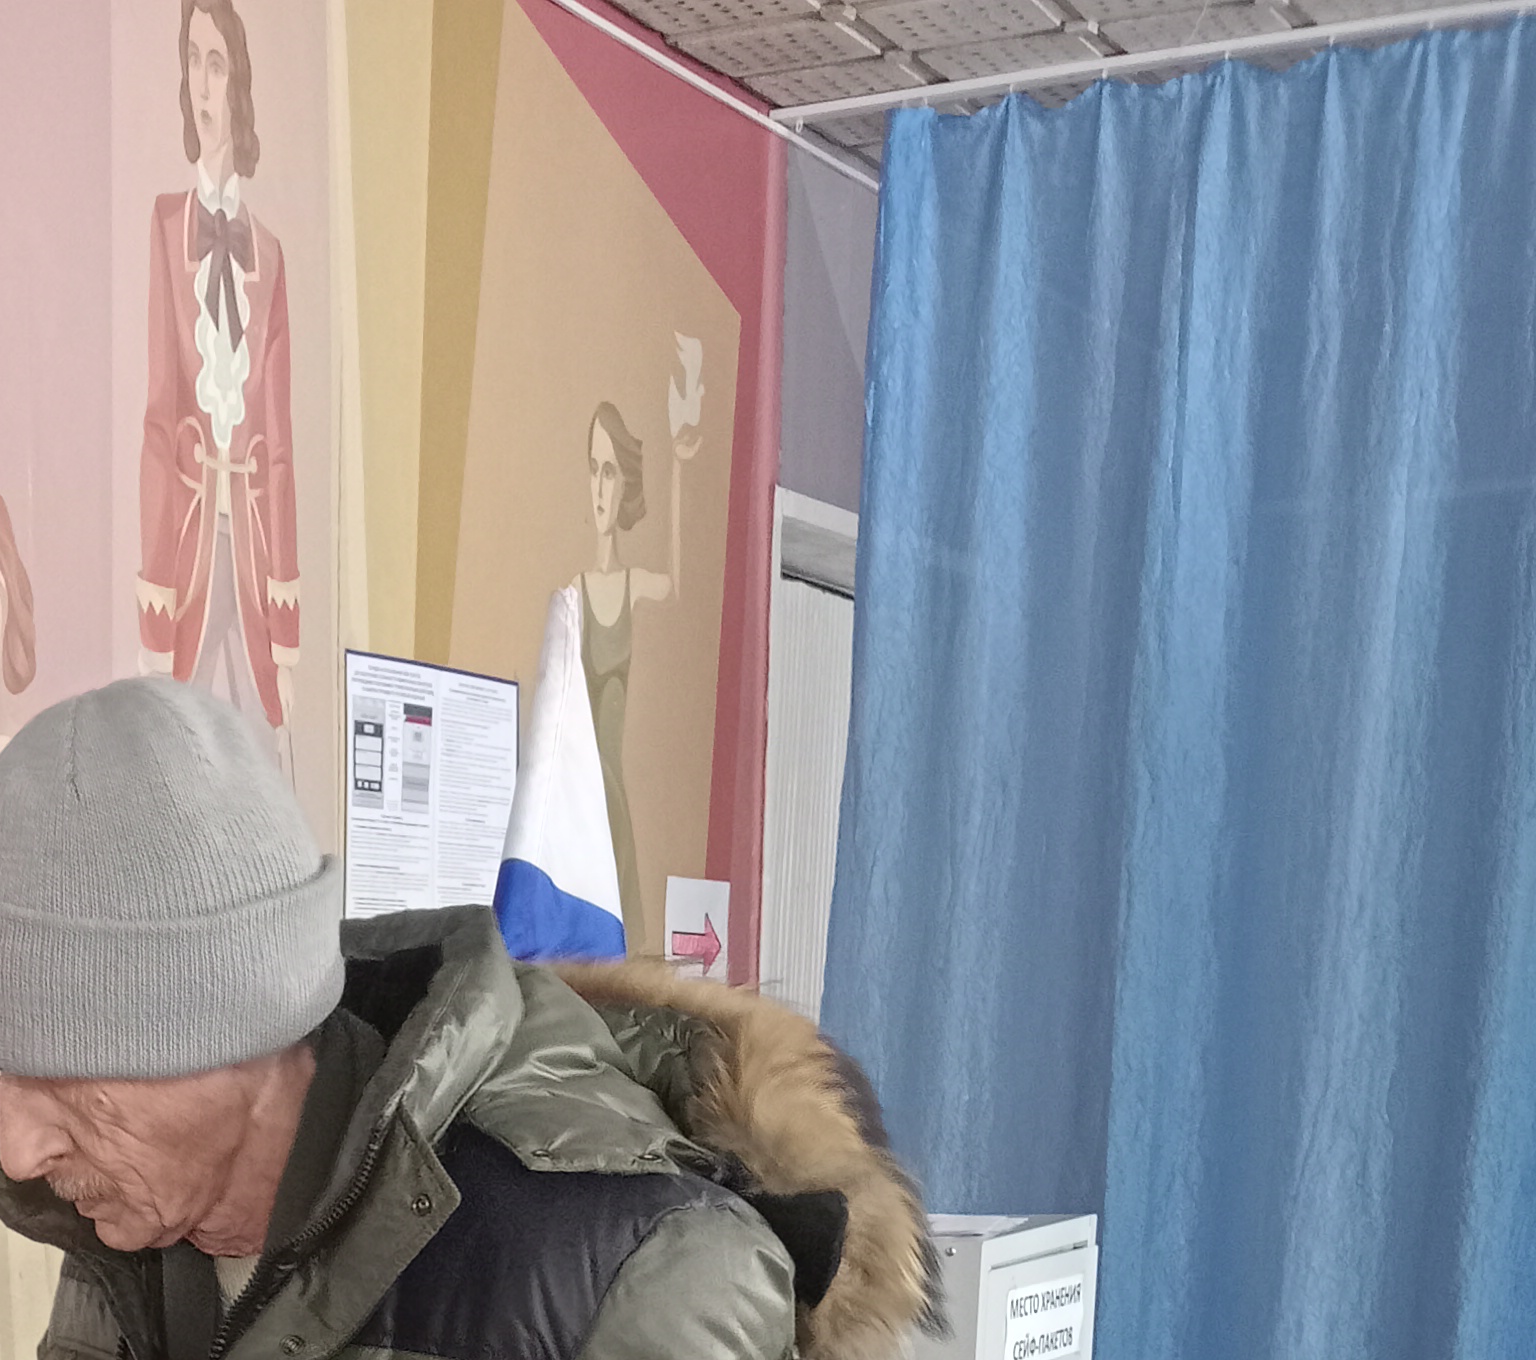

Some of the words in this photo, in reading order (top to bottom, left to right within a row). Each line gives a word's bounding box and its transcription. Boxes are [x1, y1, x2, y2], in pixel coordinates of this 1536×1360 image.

[1009, 1293, 1040, 1320] МЕСТО
[1040, 1282, 1082, 1312] ХРАНЕНИЯ
[1012, 1326, 1073, 1360] СЕЙФ-ПАКЕТОВ
